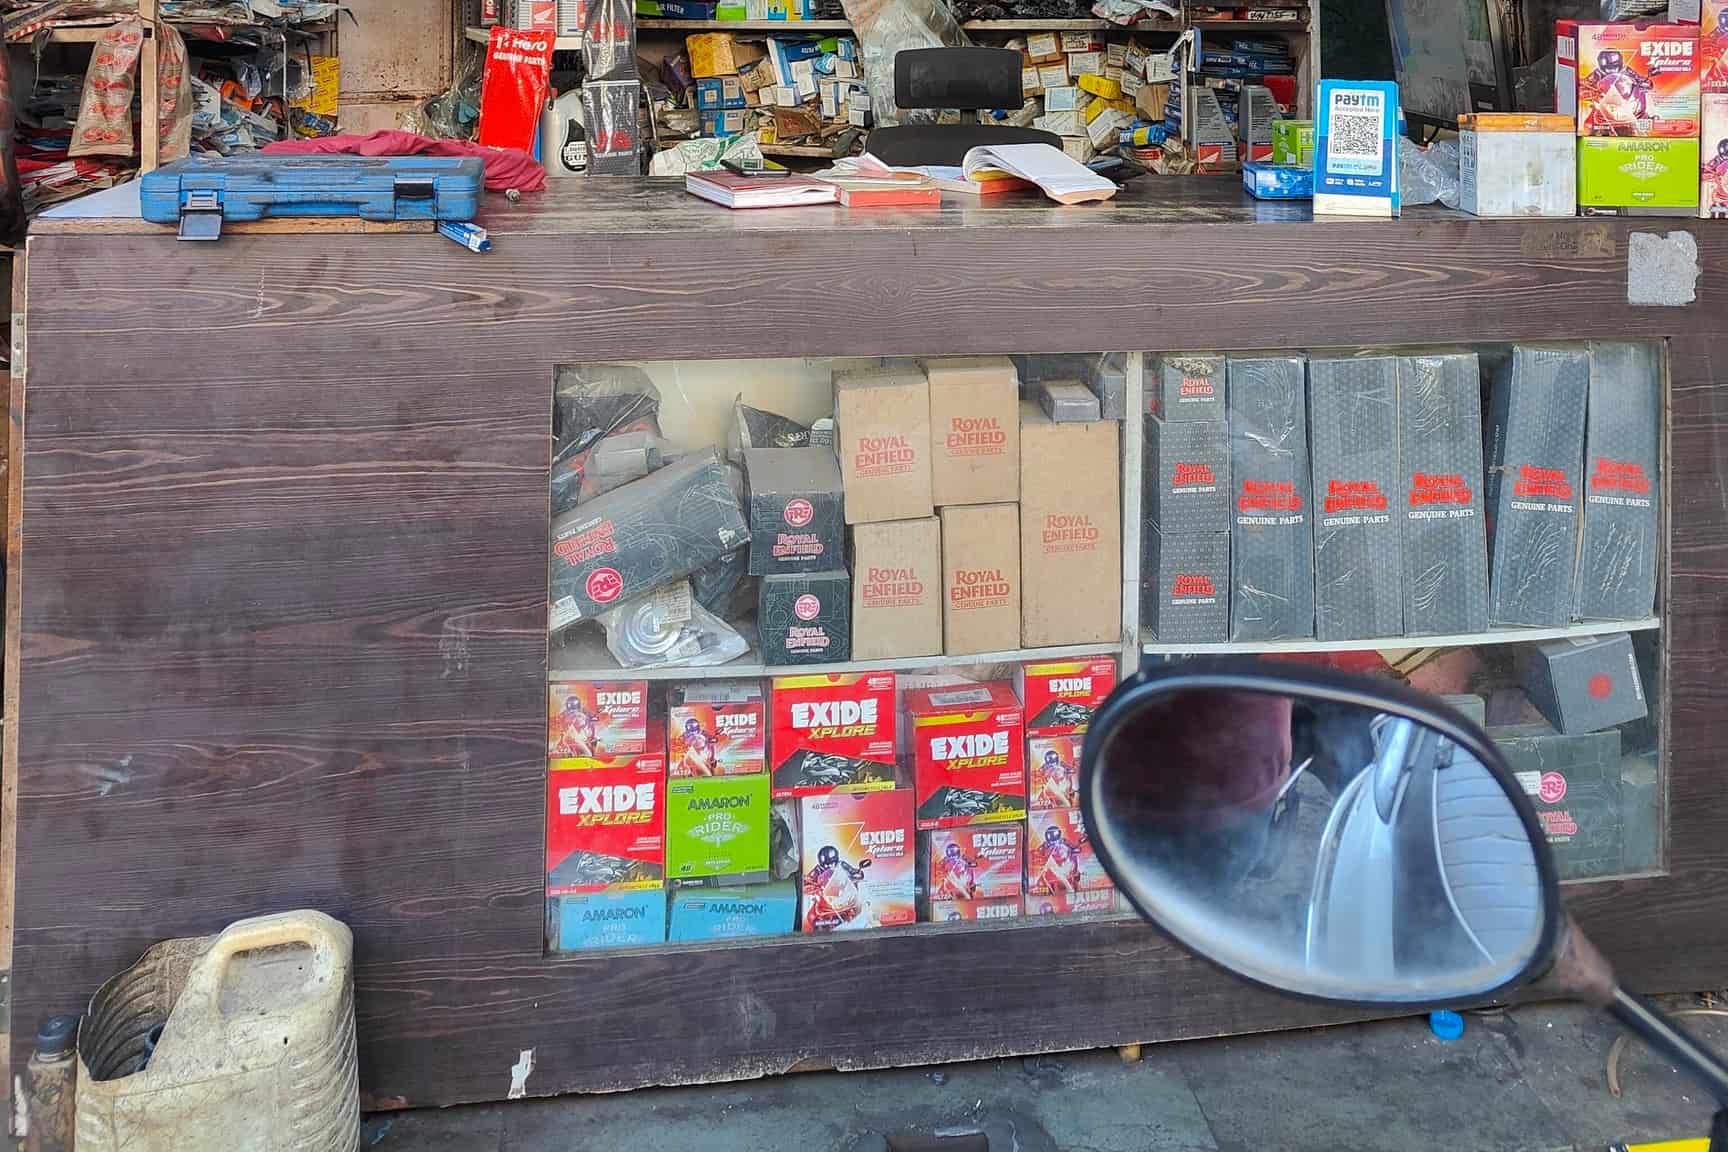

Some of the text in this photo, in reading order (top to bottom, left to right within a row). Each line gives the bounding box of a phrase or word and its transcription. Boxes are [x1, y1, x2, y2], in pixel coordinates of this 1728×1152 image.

[666, 4, 685, 14] FILTER
[1640, 41, 1693, 57] EXIDE
[1335, 93, 1380, 107] paytm
[1618, 142, 1670, 152] AMARON
[952, 417, 1001, 433] ROYAL
[859, 436, 910, 452] ROYAL
[946, 431, 1006, 448] ENFIELD
[855, 448, 915, 468] ENFIELD
[1511, 501, 1573, 513] GENUINE PARTS
[1589, 495, 1650, 507] GENUINE PARTS
[1046, 514, 1092, 529] ROYAL
[1237, 515, 1304, 525] GENUINE PARTS
[1323, 515, 1390, 526] GENUINE PARTS
[1408, 508, 1475, 520] GENUINE PARTS
[1042, 527, 1098, 543] ENFIELD
[868, 567, 917, 583] ROYAL
[956, 569, 1003, 584] ROYAL
[862, 582, 923, 598] ENFIELD
[951, 582, 1010, 600] ENFIELD
[1049, 677, 1092, 692] EXIDE
[596, 691, 641, 705] EXIDE
[715, 713, 756, 727] EXIDE
[791, 698, 878, 728] EXIDE
[808, 725, 877, 739] XPLORE
[931, 731, 1009, 761] EXIDE
[946, 755, 1008, 770] XPLORE
[559, 783, 656, 815] EXIDE
[688, 795, 751, 810] AMARON
[576, 811, 654, 827] XPLORE
[708, 812, 731, 822] PRO
[695, 821, 743, 834] RIDER
[860, 829, 905, 846] EXIDE
[972, 831, 1017, 847] EXIDE
[1066, 890, 1110, 904] EXIDE
[582, 906, 646, 921] AMARON
[709, 903, 765, 914] AMARON
[976, 904, 1018, 919] EXIDE
